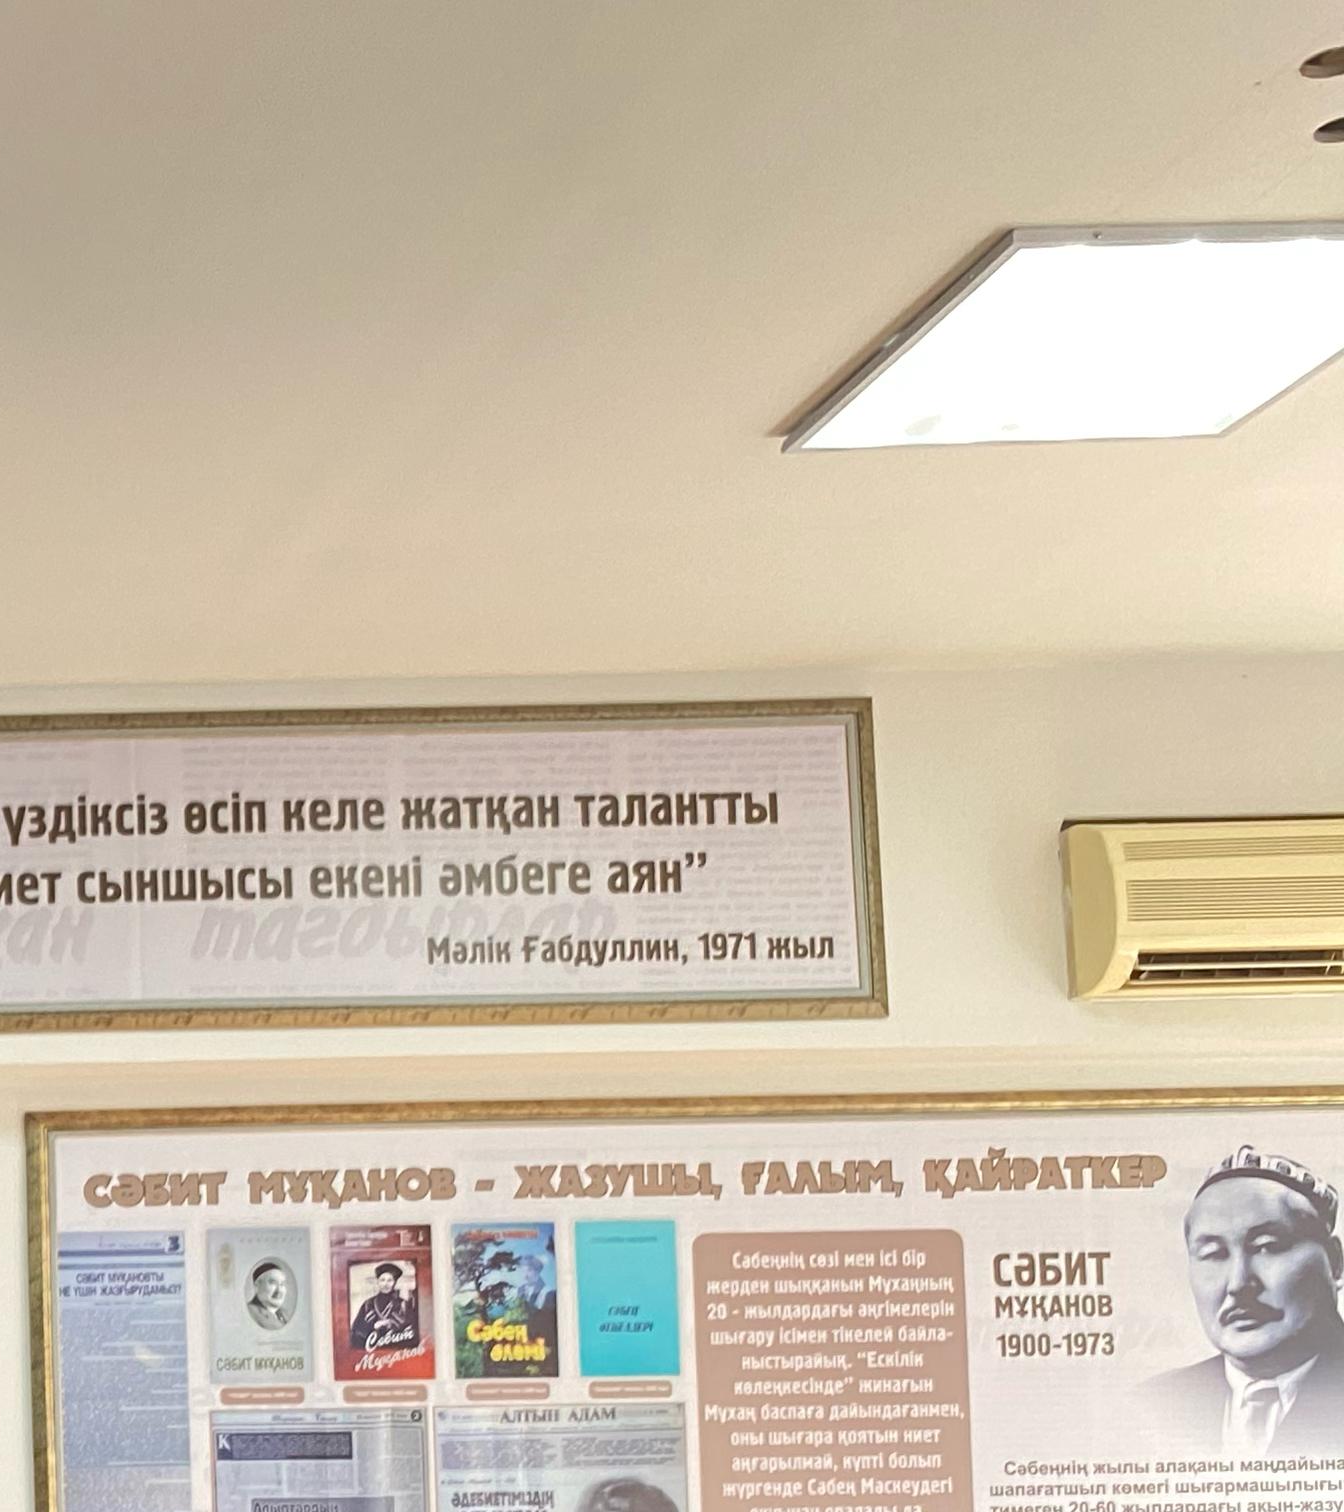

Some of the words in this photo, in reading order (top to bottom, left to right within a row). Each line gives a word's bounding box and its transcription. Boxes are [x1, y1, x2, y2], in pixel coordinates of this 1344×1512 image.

[3, 795, 168, 847] үздіксіз
[184, 795, 266, 834] өсіп
[283, 795, 385, 832] келе
[401, 795, 560, 836] жатқан
[574, 790, 779, 828] талантты
[77, 864, 292, 904] сыншысы
[310, 856, 421, 899] екені
[439, 853, 592, 897] әмбеге
[608, 852, 707, 894] аян”
[427, 937, 510, 966] Мәлік
[522, 936, 687, 967] Ғабдуллин,
[699, 934, 755, 961] 1971
[767, 934, 834, 960] жыл
[83, 1171, 226, 1207] СӘБИТ
[248, 1167, 457, 1209] МҰҚАНОВ
[515, 1162, 722, 1200] ЖАЗУШЫ,
[742, 1159, 904, 1197] ҒАЛЫМ,
[923, 1147, 1167, 1198] ҚАЙРАТКЕР
[810, 1251, 839, 1268] сөзі
[845, 1252, 875, 1267] мен
[902, 1249, 926, 1271] бір
[993, 1252, 1110, 1286] СӘБИТ
[707, 1279, 770, 1297] жерден
[707, 1306, 728, 1320] 20
[744, 1303, 854, 1321] жылдардағы
[995, 1294, 1112, 1321] МҰҚАНОВ
[710, 1328, 775, 1348] шығару
[779, 1327, 827, 1344] ісімен
[832, 1325, 894, 1344] тікелей
[997, 1333, 1114, 1357] 1900-1973
[859, 1377, 933, 1393] жинағын
[568, 1407, 616, 1422] АДАМ
[760, 1402, 824, 1422] баспаға
[730, 1431, 764, 1446] оны
[768, 1430, 833, 1449] шығара
[838, 1429, 898, 1447] қоятын
[903, 1428, 940, 1443] ниет
[889, 1452, 942, 1469] болып
[1004, 1461, 1088, 1477] Сәбеңнің
[1093, 1462, 1149, 1475] жылы
[1155, 1461, 1233, 1477] алақаны
[722, 1480, 803, 1499] жүргенде
[989, 1482, 1106, 1498] шапағатшыл
[1112, 1479, 1170, 1496] көмегі
[1175, 1479, 1344, 1496] шығармашылығы
